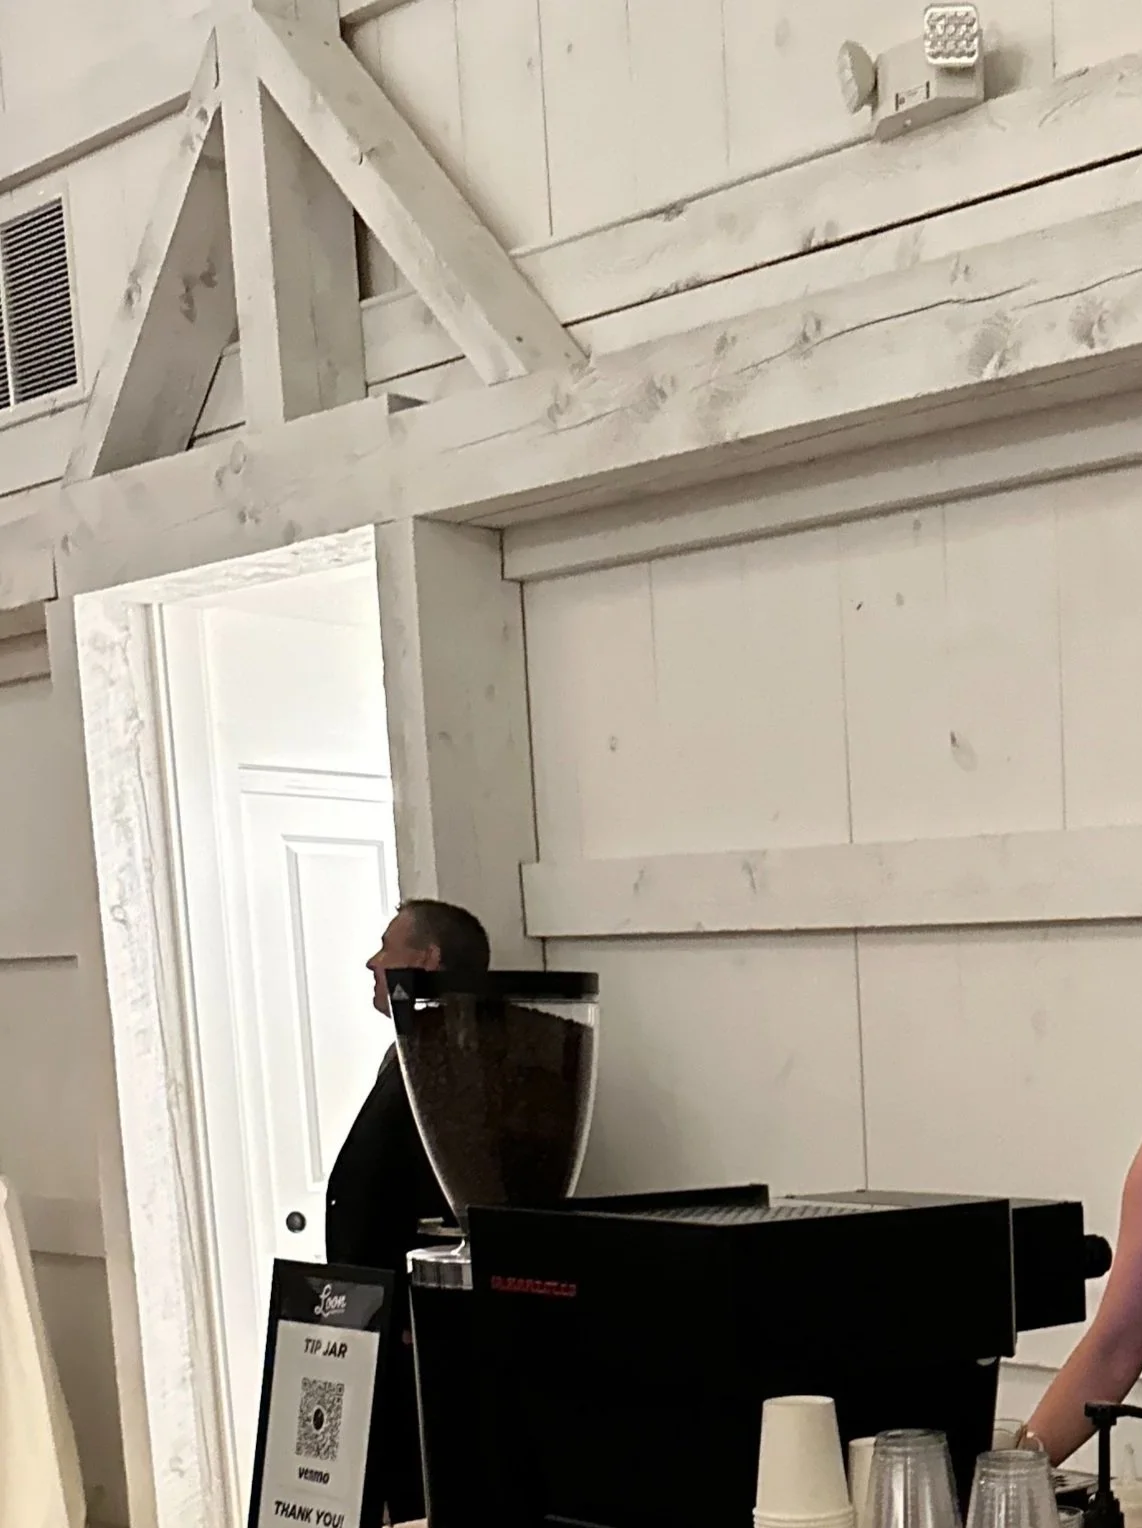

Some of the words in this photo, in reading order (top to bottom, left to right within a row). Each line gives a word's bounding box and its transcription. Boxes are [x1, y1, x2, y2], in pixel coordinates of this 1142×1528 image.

[314, 1284, 347, 1317] Loon
[304, 1338, 322, 1354] TIP
[323, 1342, 348, 1358] JAR
[274, 1500, 314, 1523] THANK
